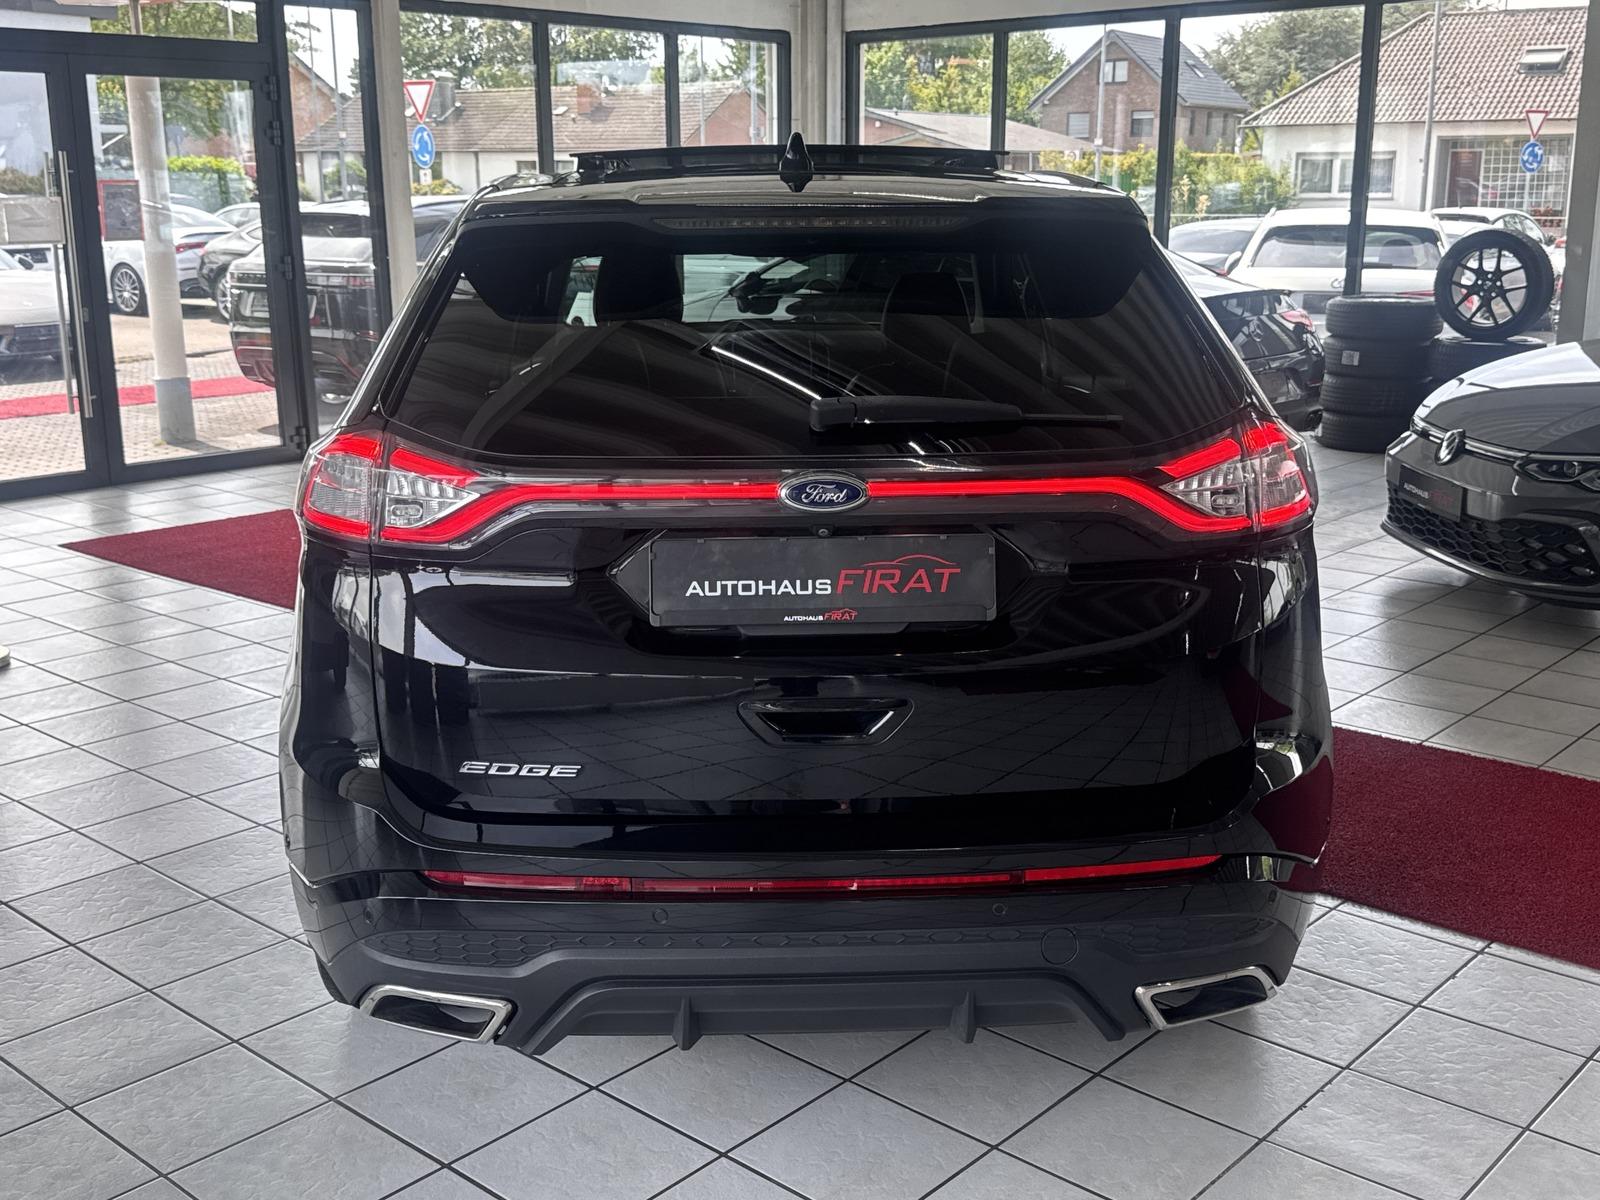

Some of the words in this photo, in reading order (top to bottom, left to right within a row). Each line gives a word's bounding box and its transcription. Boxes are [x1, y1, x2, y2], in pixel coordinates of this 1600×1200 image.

[801, 483, 849, 503] Ford
[685, 579, 832, 597] AUTOHAUS
[836, 568, 961, 594] FIRAT
[824, 611, 857, 621] FIRAT
[458, 761, 582, 777] EDGE
